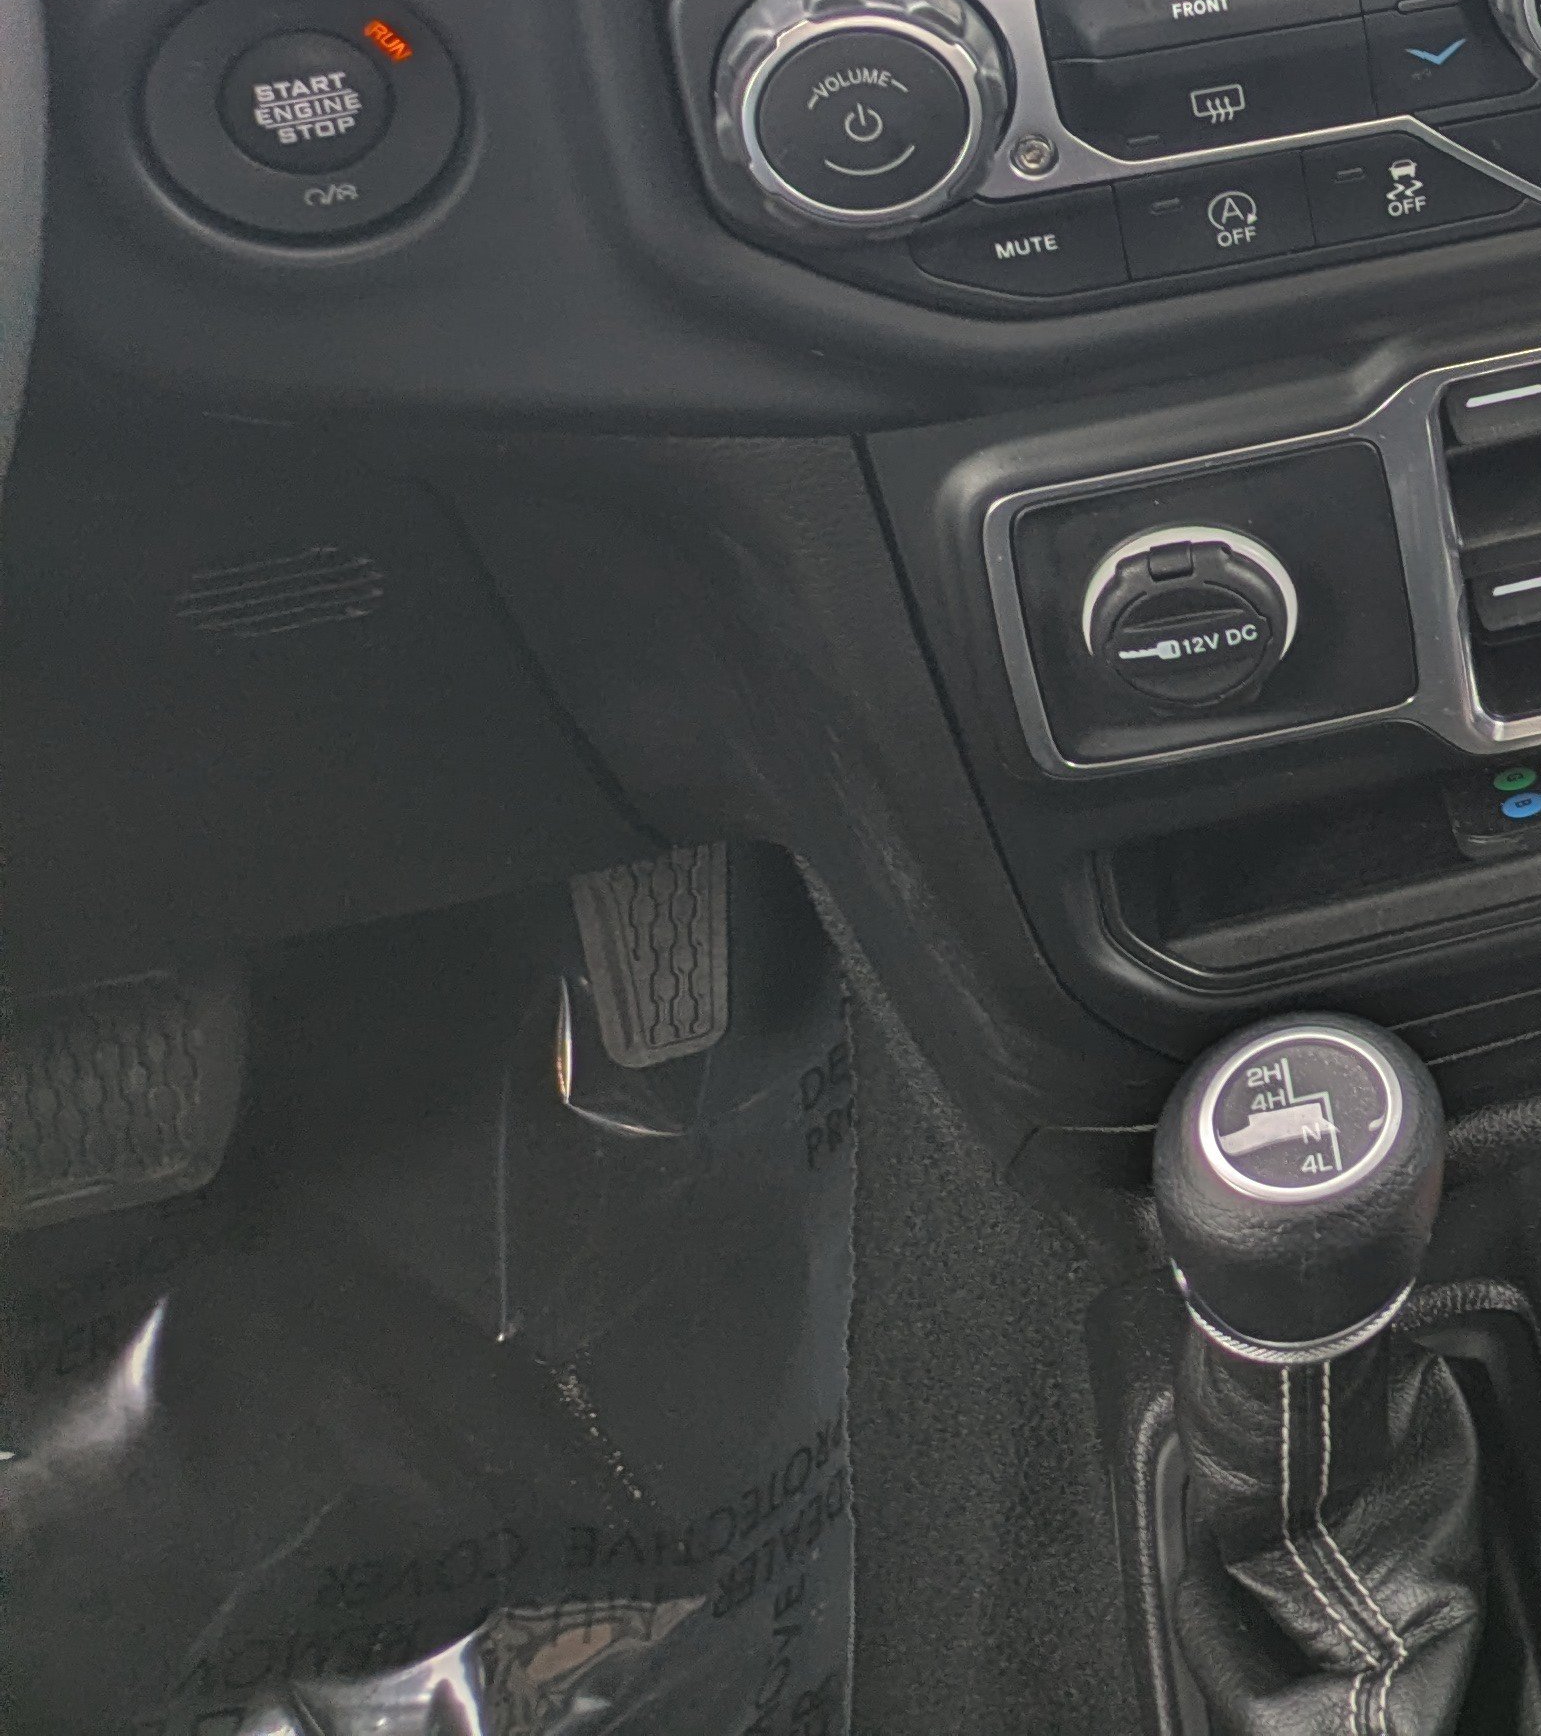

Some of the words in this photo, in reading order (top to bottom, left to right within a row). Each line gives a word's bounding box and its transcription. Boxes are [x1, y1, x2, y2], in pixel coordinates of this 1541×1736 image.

[366, 19, 413, 61] RUN
[254, 71, 347, 103] START
[812, 67, 892, 98] VOLUME
[253, 92, 363, 125] ENGINE
[277, 117, 356, 144] STOP
[1387, 196, 1427, 218] OFF
[994, 233, 1059, 260] MUTE
[1216, 226, 1257, 248] OFF
[1182, 628, 1221, 655] 12V
[1224, 624, 1258, 647] DC
[1246, 1062, 1282, 1088] 2H
[1250, 1088, 1287, 1112] 4H
[1302, 1122, 1323, 1145] N
[1299, 1153, 1333, 1175] 4L
